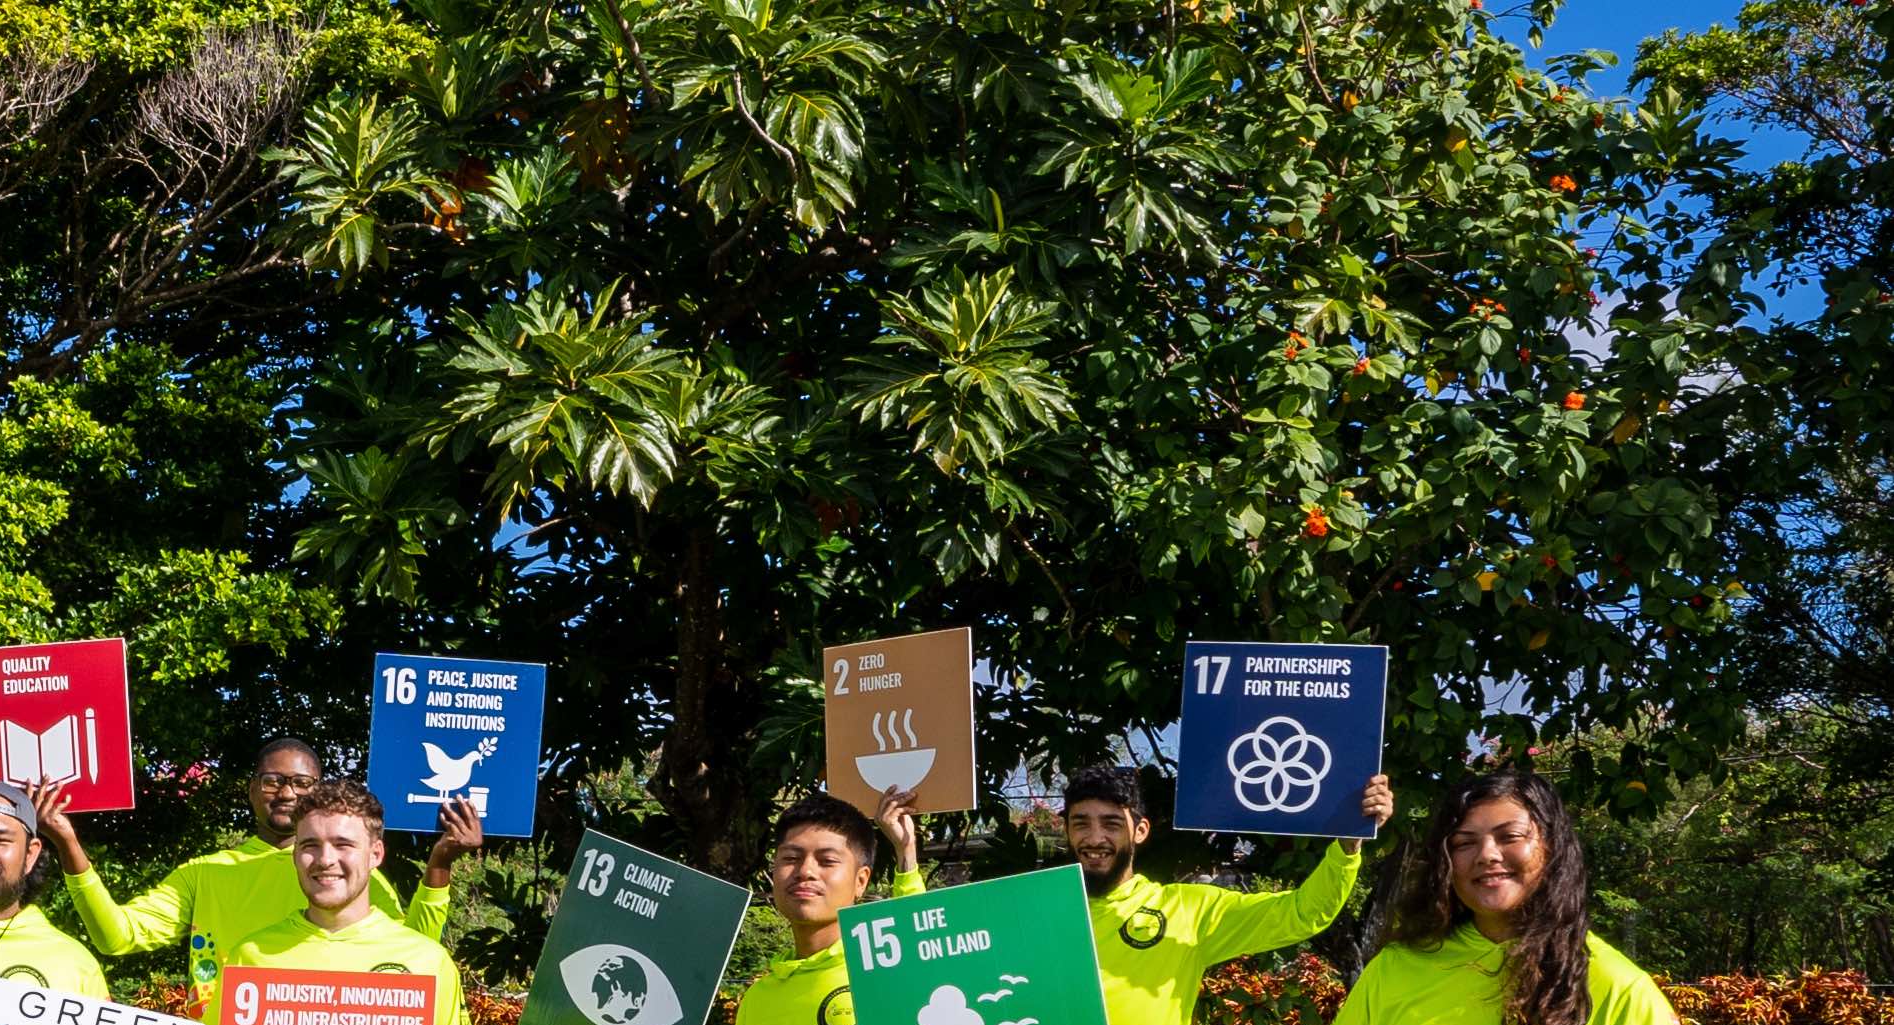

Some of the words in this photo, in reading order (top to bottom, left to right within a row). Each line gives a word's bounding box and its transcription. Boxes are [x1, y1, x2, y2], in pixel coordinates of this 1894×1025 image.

[2, 656, 50, 675] QUALITY
[859, 654, 884, 670] ZERO
[1246, 657, 1351, 675] PARTNERSHIPS
[4, 676, 68, 694] EDUCATION
[383, 668, 416, 704] 16
[429, 670, 468, 688] PEACE,
[471, 673, 517, 690] JUSTICE
[834, 659, 849, 695] 2
[860, 673, 901, 692] HUNGER
[1194, 656, 1230, 694] 17
[427, 691, 452, 706] AND
[455, 693, 502, 710] STRONG
[1245, 680, 1271, 695] FOR
[1275, 681, 1301, 696] THE
[1304, 682, 1350, 698] GOALS
[426, 712, 505, 731] INSTITUTIONS
[578, 849, 615, 896] 13
[624, 864, 674, 896] CLIMATE
[614, 889, 658, 919] ACTION
[913, 908, 946, 931] LIFE
[851, 917, 901, 970] 15
[918, 938, 943, 960] ON
[946, 930, 990, 956] LAND
[235, 982, 259, 1025] 9
[266, 984, 337, 1006] INDUSTRY,
[341, 987, 425, 1008] INNOVATION
